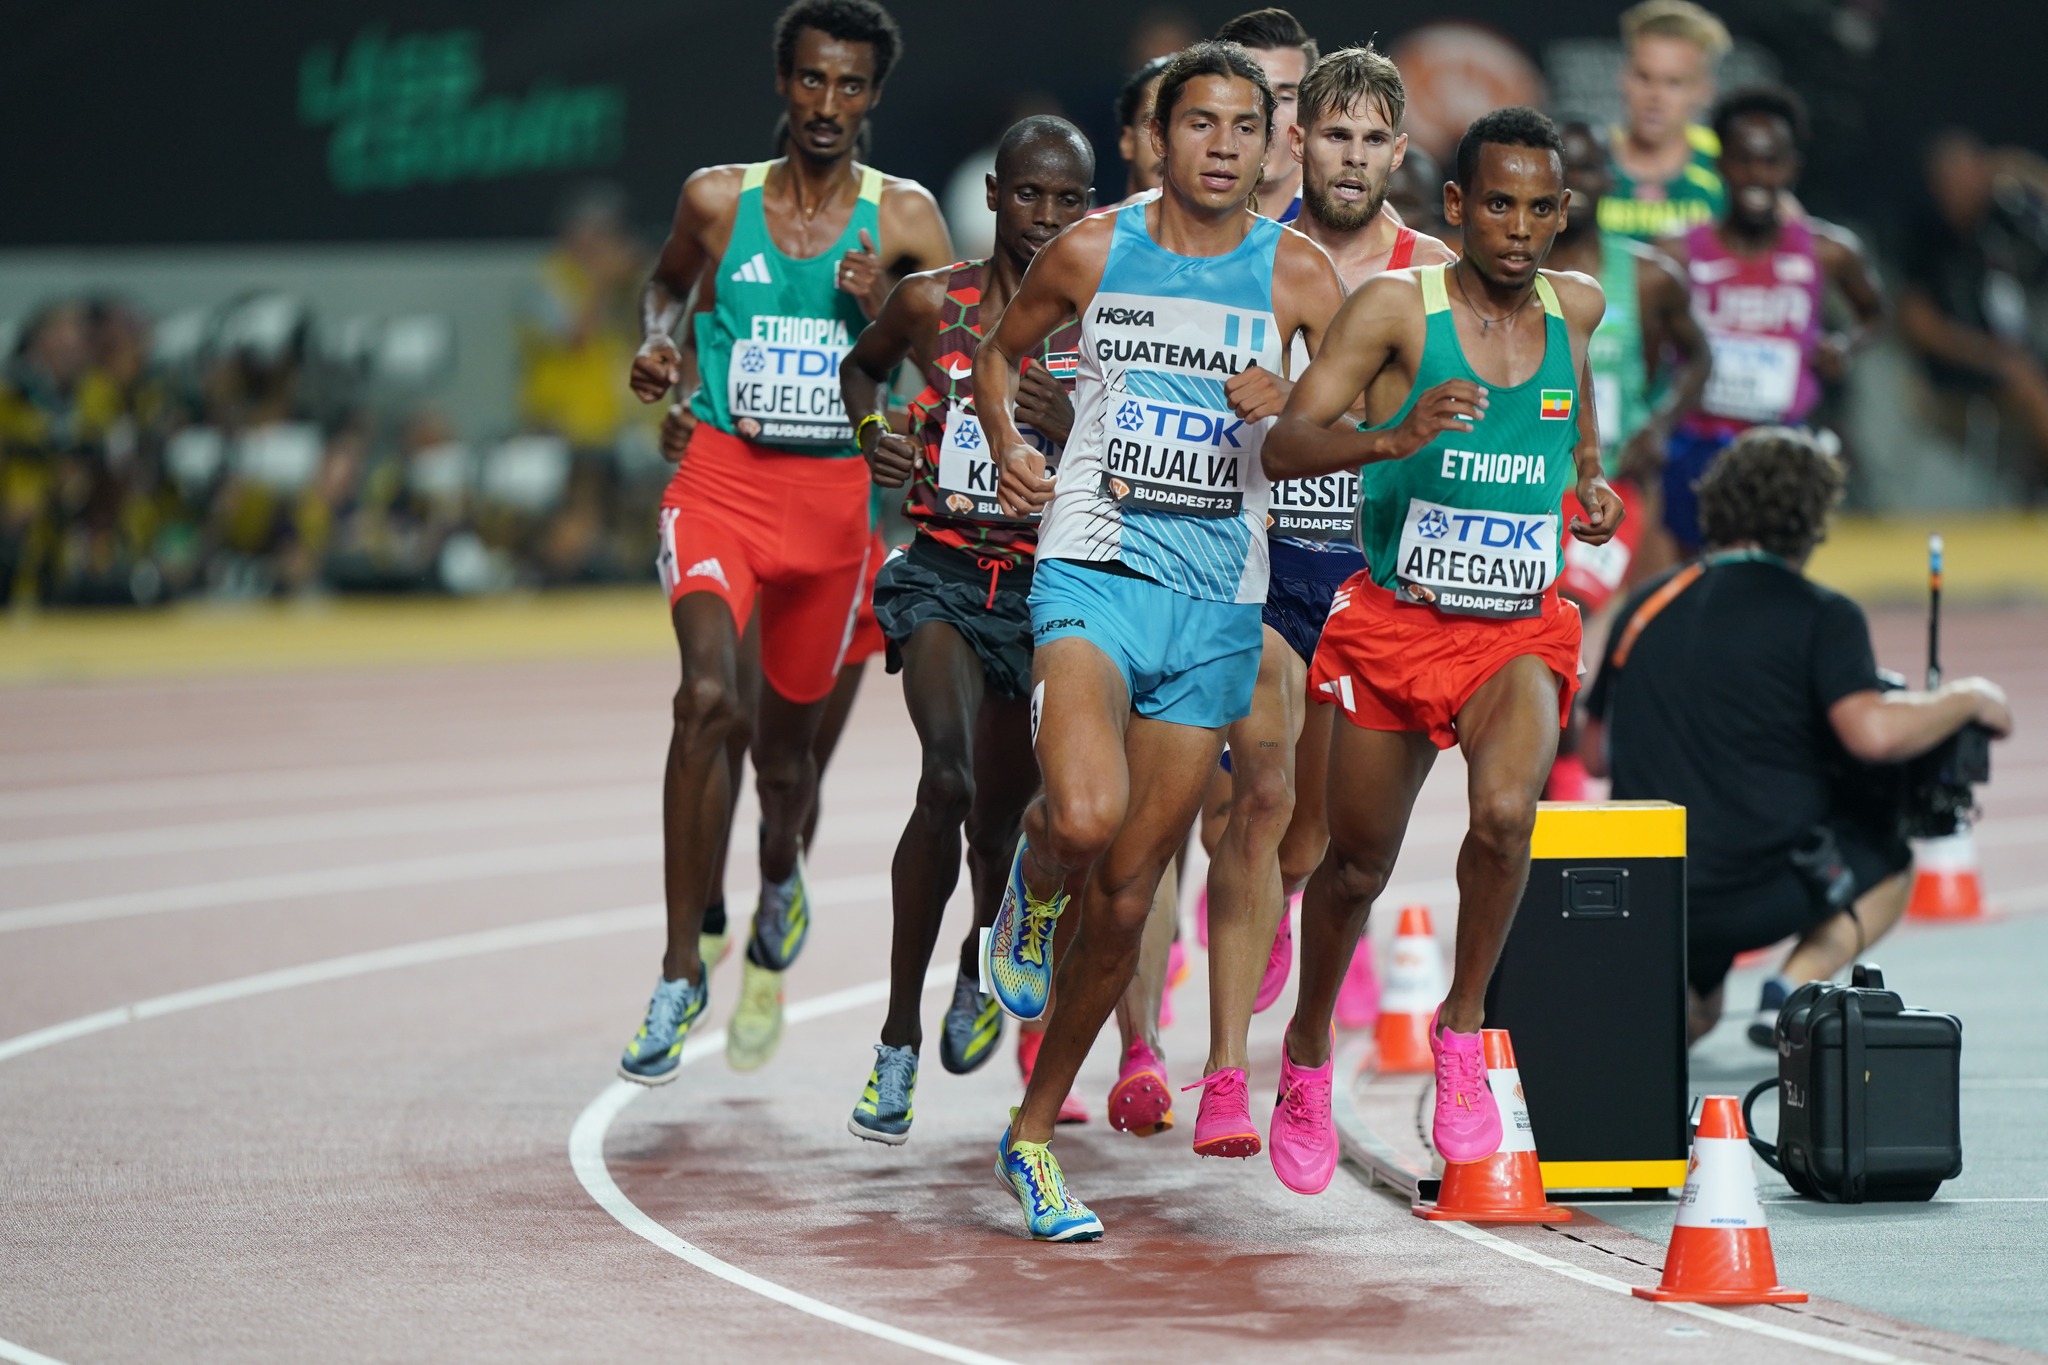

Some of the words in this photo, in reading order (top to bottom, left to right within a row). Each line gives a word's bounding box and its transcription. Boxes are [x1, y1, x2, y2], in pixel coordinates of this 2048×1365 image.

[751, 314, 850, 346] ETHIOPIA
[1096, 307, 1154, 327] HOKA
[1096, 339, 1257, 377] GUATEMALA
[736, 382, 848, 417] KEJELCH
[1146, 404, 1245, 449] TDK
[1107, 437, 1239, 488] GRIJALVA
[1441, 448, 1545, 485] ETHIOPIA
[1134, 486, 1216, 509] BUDAPEST
[1280, 516, 1355, 531] BUDAPES
[1452, 514, 1547, 551] TDK
[1404, 546, 1546, 591] AREGAWI
[1440, 592, 1520, 612] BUDAPEST
